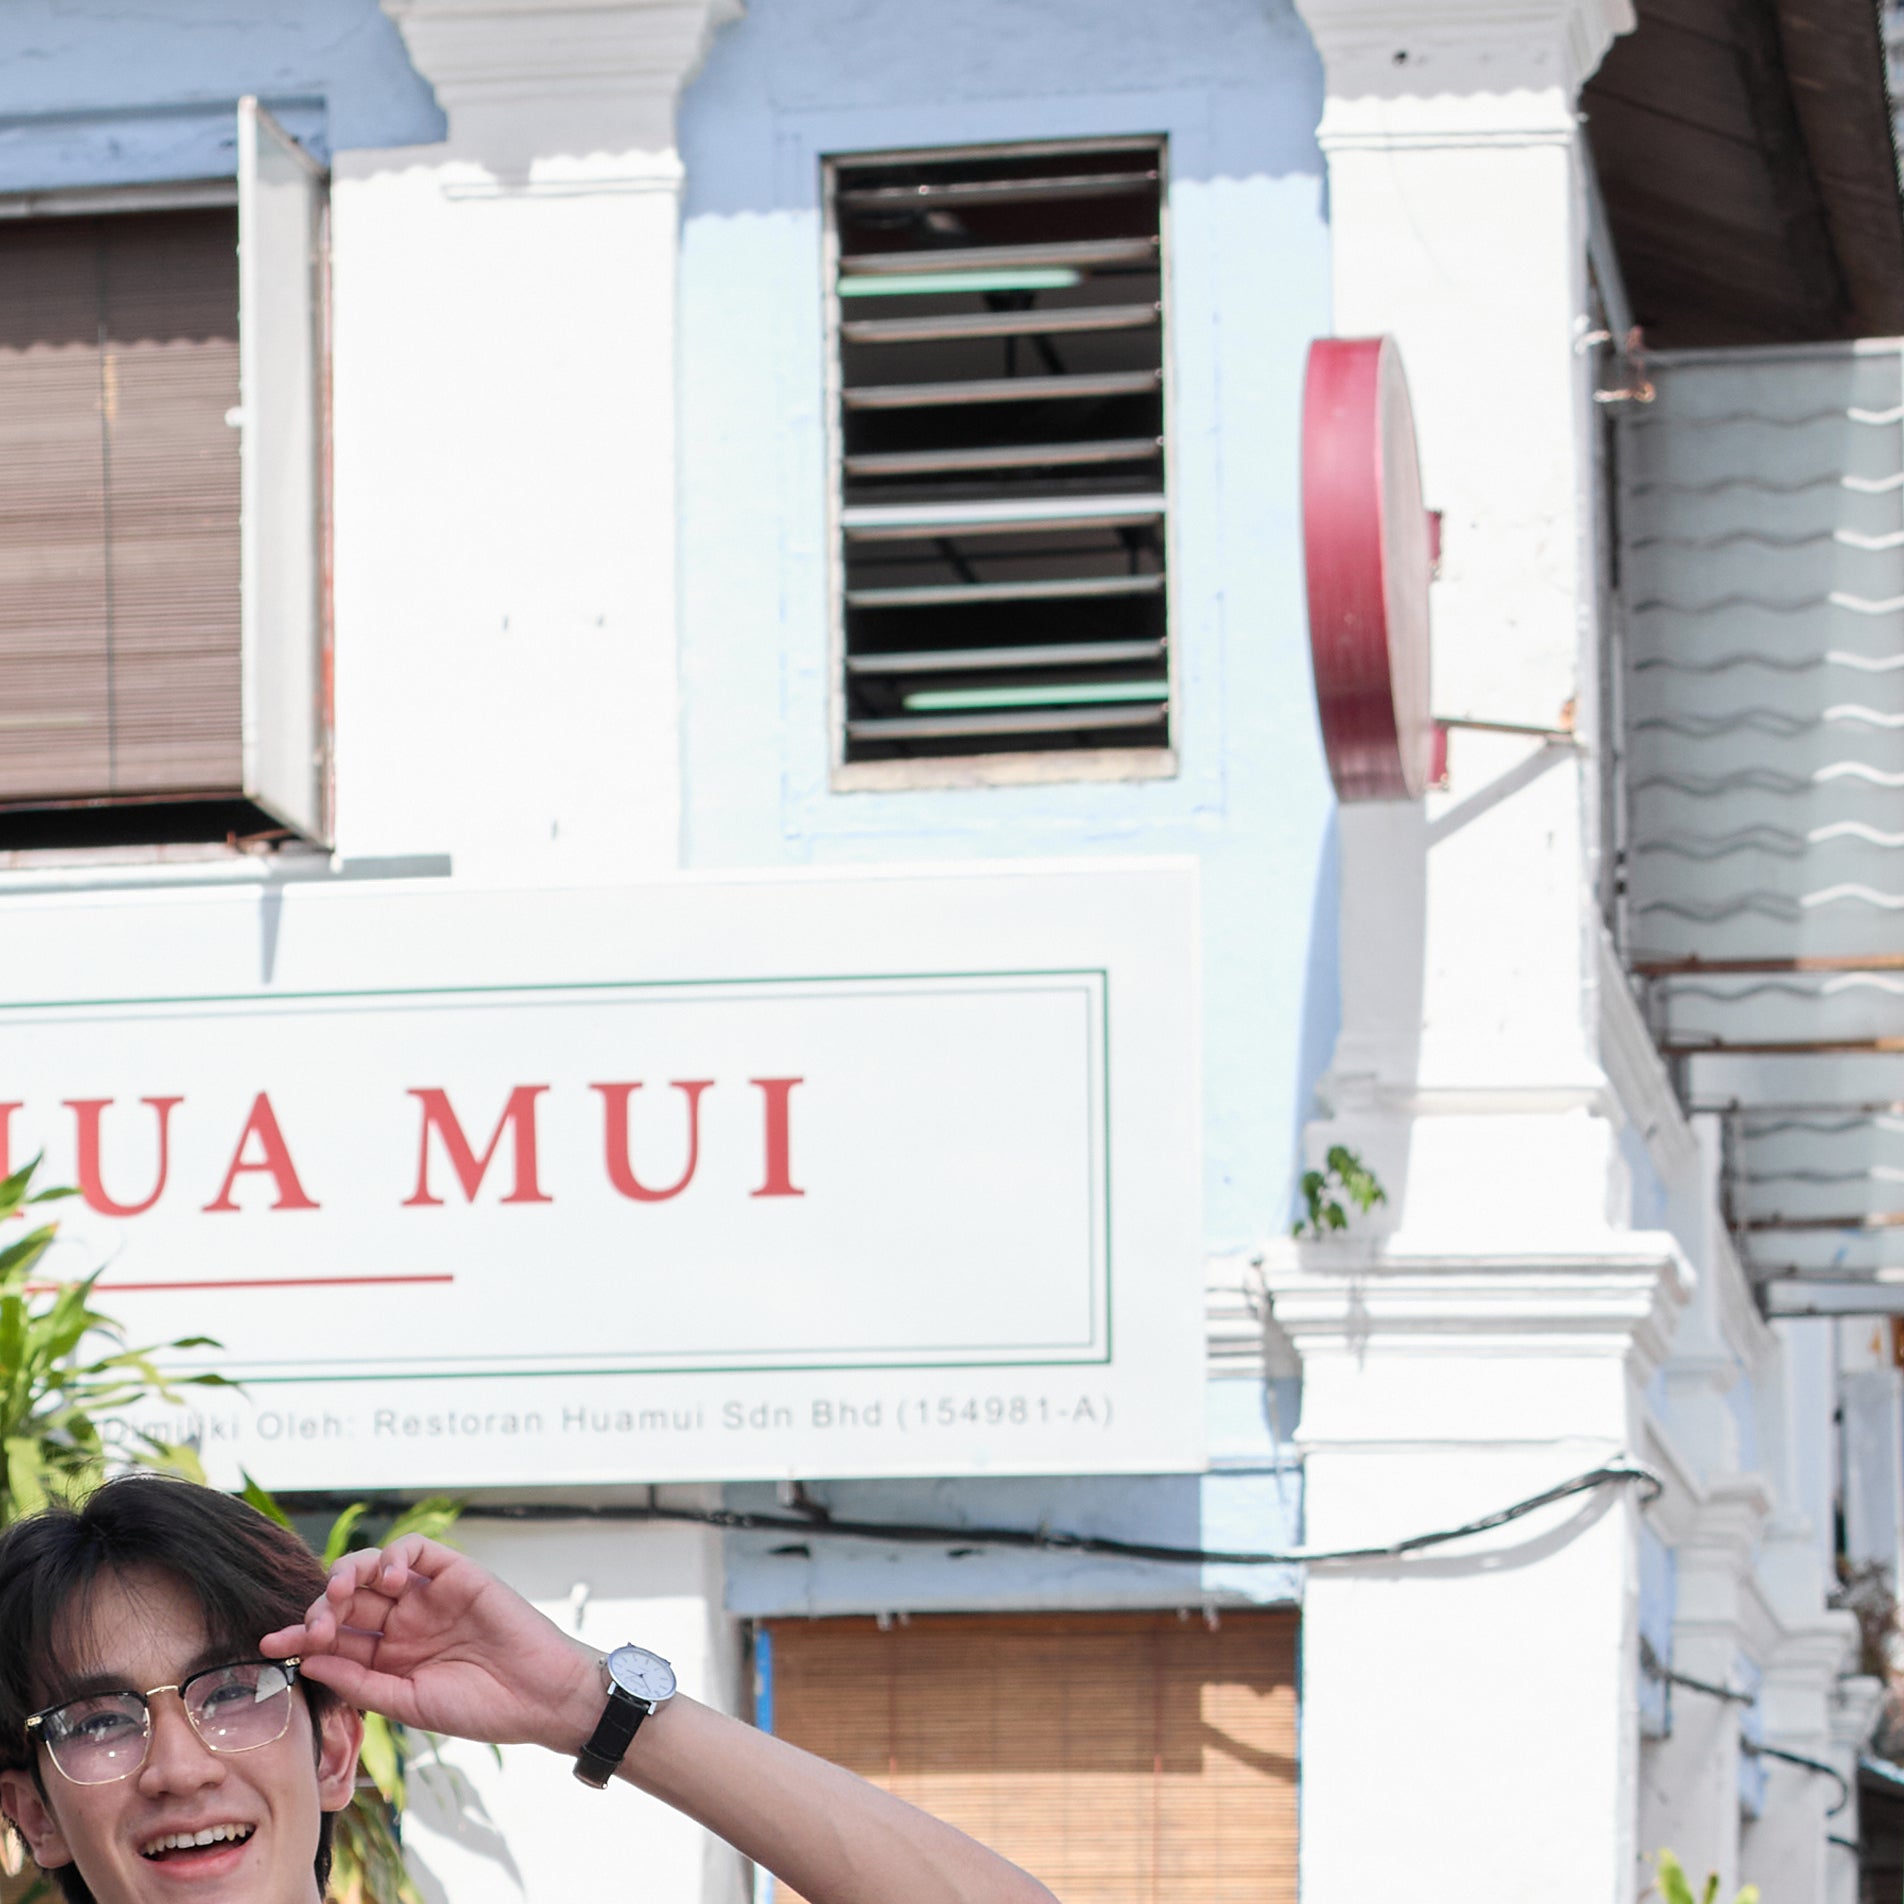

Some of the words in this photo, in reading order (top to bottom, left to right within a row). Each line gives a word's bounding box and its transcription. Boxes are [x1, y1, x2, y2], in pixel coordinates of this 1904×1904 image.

[401, 1076, 807, 1208] MUI
[373, 1408, 545, 1439] Restoran
[561, 1405, 706, 1436] Huamui
[722, 1400, 795, 1432] Sdn
[810, 1398, 884, 1431] Bhd
[896, 1394, 1116, 1434] (154981-A)
